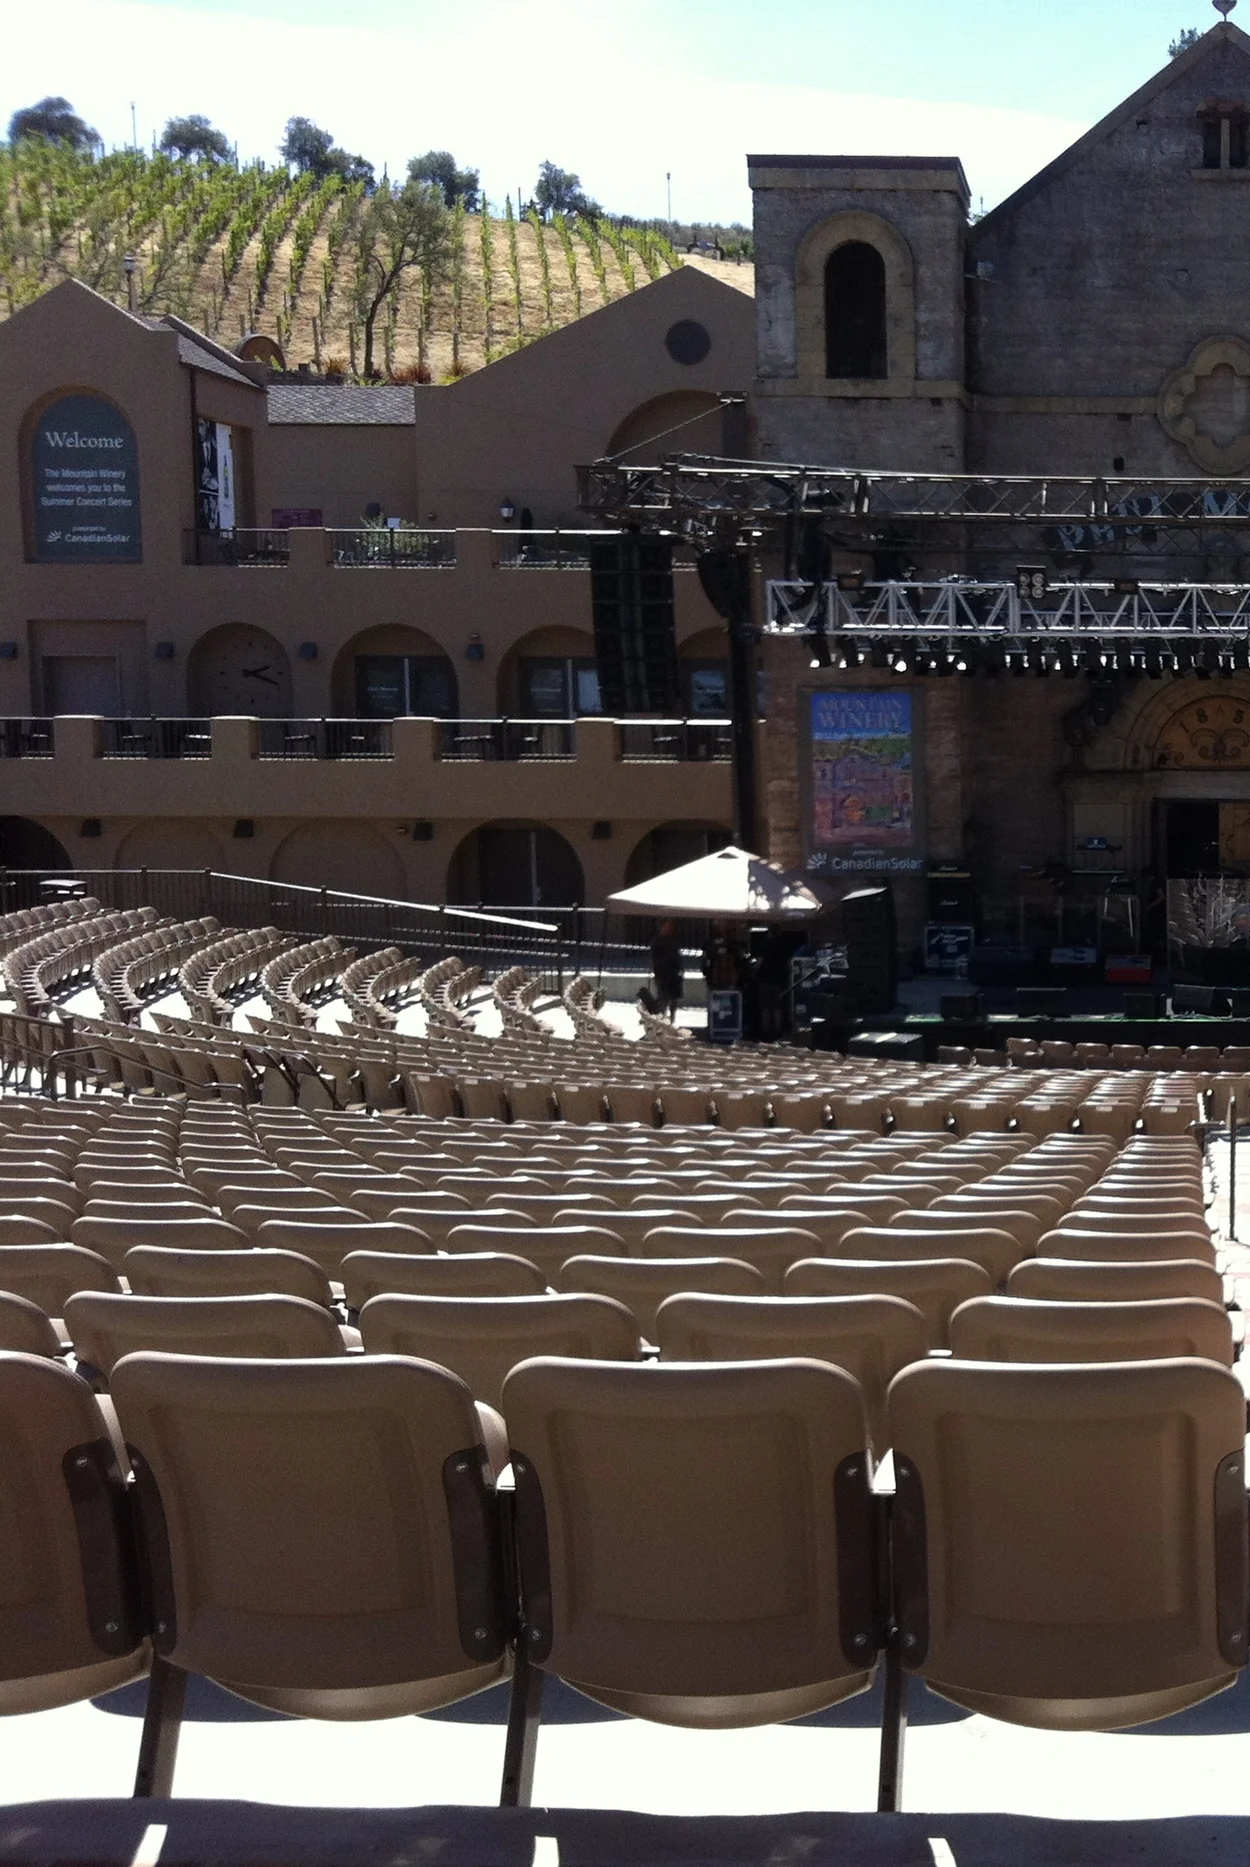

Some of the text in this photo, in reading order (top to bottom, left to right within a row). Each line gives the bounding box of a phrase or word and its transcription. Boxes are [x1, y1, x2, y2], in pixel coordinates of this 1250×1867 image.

[45, 431, 124, 448] Welcome
[64, 533, 131, 543] CanadianSolar
[819, 711, 904, 728] WINERY
[831, 857, 924, 870] CanadianSolar
